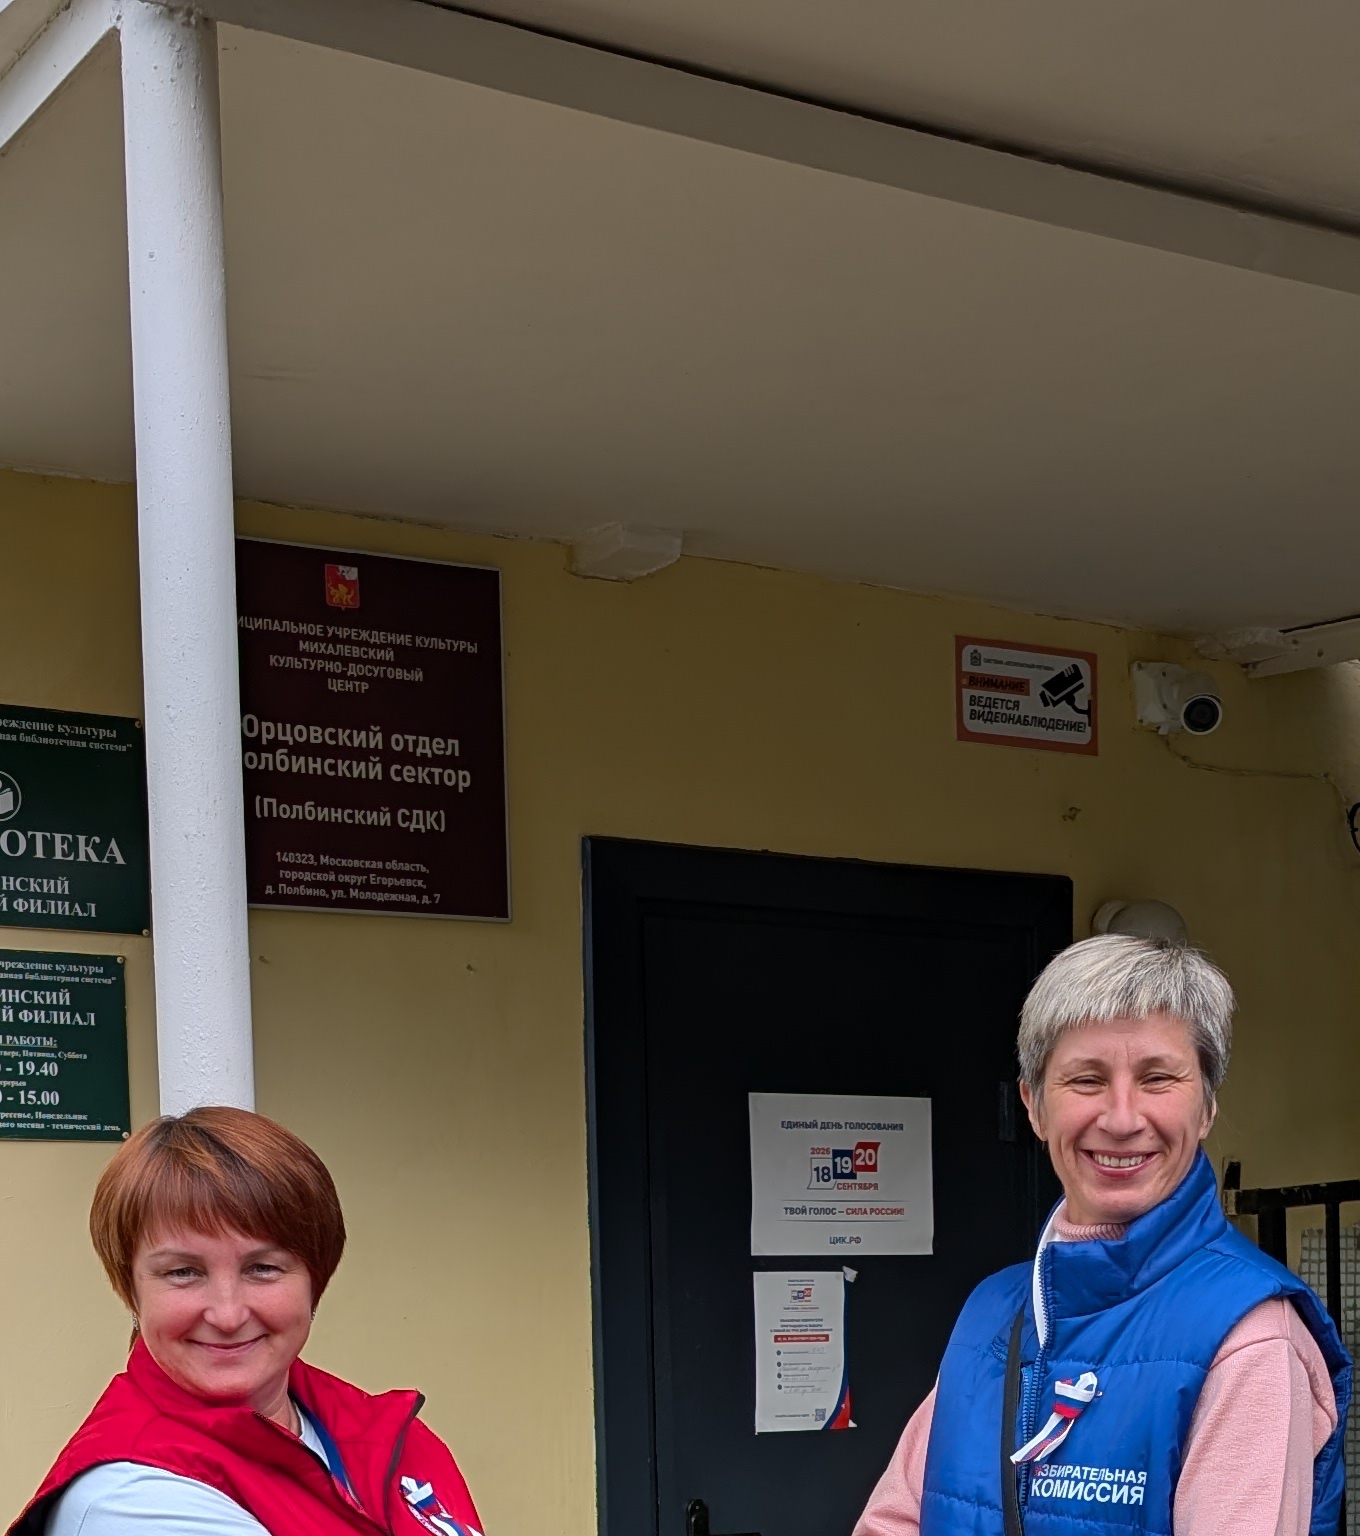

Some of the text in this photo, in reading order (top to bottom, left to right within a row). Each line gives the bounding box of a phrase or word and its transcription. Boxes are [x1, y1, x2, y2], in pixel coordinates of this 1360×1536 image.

[326, 626, 413, 647] УЧРЕЖДЕНИЕ
[415, 636, 478, 654] КУЛЬТУРЫ
[299, 640, 395, 661] МИХАЛЕВСКИЙ
[269, 655, 423, 682] КУЛЬТУРНО-ДОСУГОВЫЙ
[328, 678, 369, 693] ЦЕНТР
[968, 675, 1025, 692] ВНИМАНИЕ
[969, 695, 1020, 711] ВЕДЕТСЯ
[58, 723, 117, 739] культуры
[969, 709, 1087, 733] ВИДЕОНАБЛЮДЕНИЕ!
[390, 733, 459, 758] отдел
[244, 749, 471, 793] олбинский сектор
[255, 795, 446, 833] (Полбинский СДК)
[276, 851, 430, 874] 140323, Московская область,
[279, 869, 427, 889] городской округ Егорьевск,
[265, 885, 276, 895] д.
[278, 884, 329, 899] Полбино,
[331, 889, 347, 899] ул.
[349, 888, 419, 904] Молодежная,
[434, 893, 441, 904] 7
[13, 898, 97, 918] ФИЛИАЛ
[55, 963, 104, 975] культуры
[18, 1011, 96, 1026] ФИЛИАЛ
[6, 1035, 58, 1047] РАБОТЫ:
[17, 1061, 59, 1076] 19.40
[19, 1090, 60, 1105] 15.00
[781, 1120, 904, 1131] ЕДИНЫЙ ДЕНЬ ГОЛОСОВАНИЯ
[813, 1149, 876, 1182] 18 19 20
[837, 1182, 878, 1191] СЕНТЯБРЯ
[784, 1206, 807, 1215] ТВОЙ
[809, 1207, 837, 1215] ГОЛОС
[846, 1207, 868, 1215] СИЛА
[1031, 1478, 1145, 1506] КОМИССИЯ
